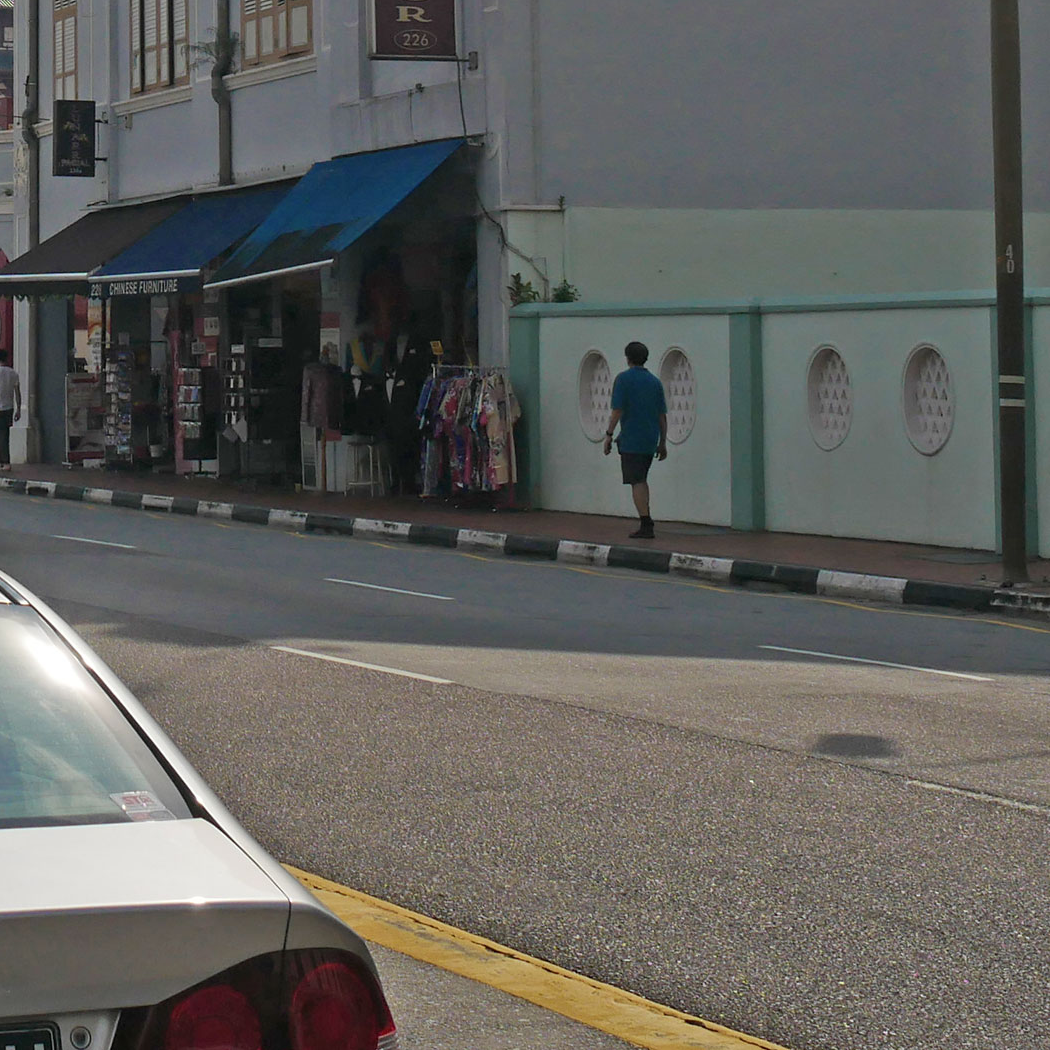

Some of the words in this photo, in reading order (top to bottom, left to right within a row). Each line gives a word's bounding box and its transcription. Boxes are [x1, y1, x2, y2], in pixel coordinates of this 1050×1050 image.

[402, 33, 429, 47] 226
[109, 281, 138, 295] CHINESE
[138, 279, 178, 294] FURNITURE
